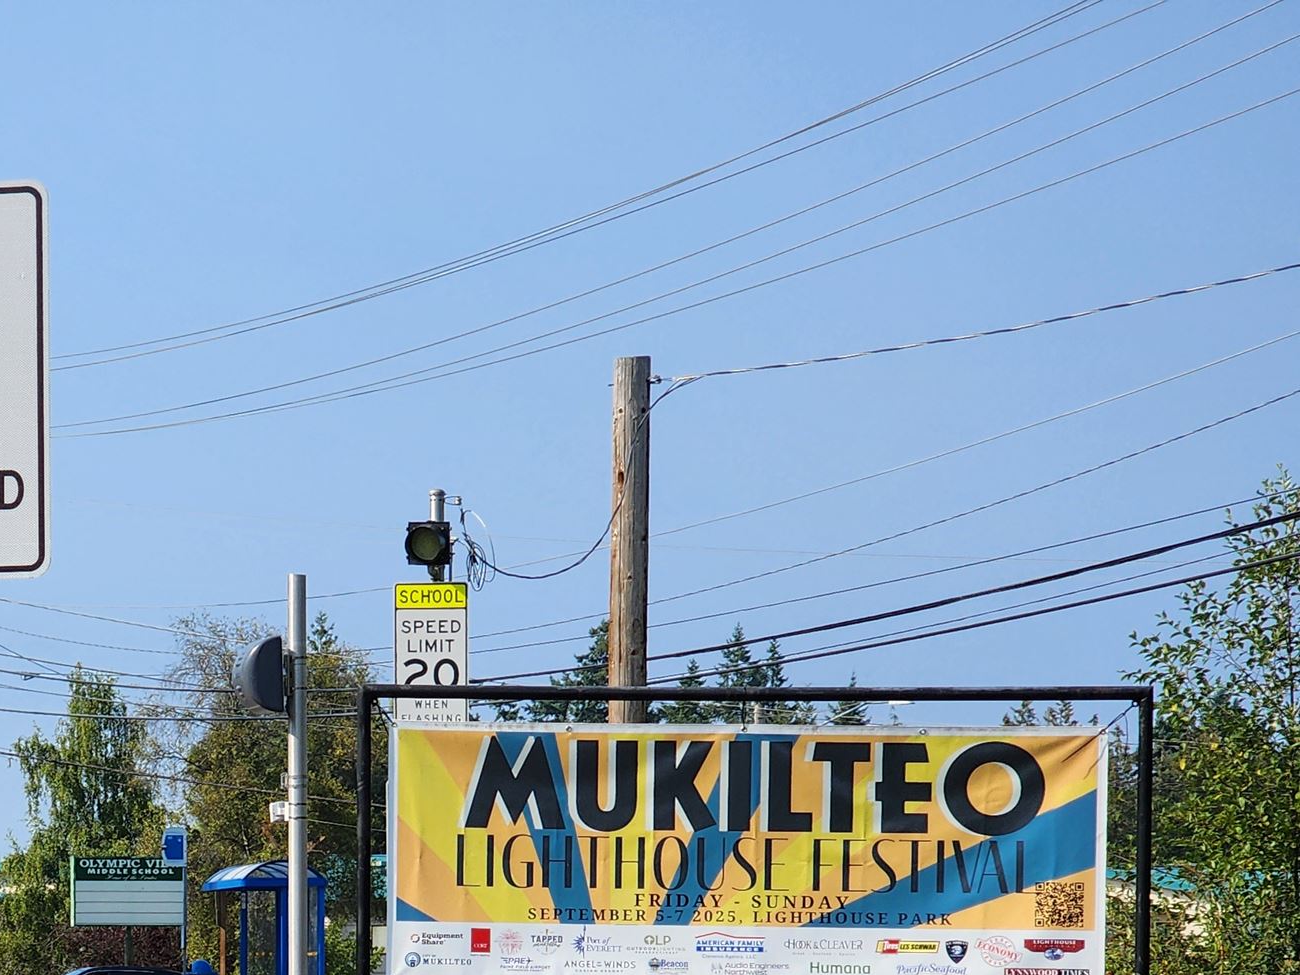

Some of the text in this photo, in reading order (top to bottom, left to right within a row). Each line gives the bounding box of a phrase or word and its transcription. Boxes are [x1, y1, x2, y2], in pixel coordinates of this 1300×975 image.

[400, 589, 464, 603] SCHOOL
[402, 620, 461, 634] SPEED
[408, 639, 455, 653] LIMIT
[404, 658, 460, 686] 20
[415, 700, 448, 709] WHEN
[458, 735, 1046, 837] MUKILTEO
[79, 859, 180, 868] OLYMPIC VIE
[456, 834, 1038, 895] LIGHTHOUSE FESTIVAL
[634, 893, 723, 908] FRIDAY
[751, 895, 850, 909] SUNDAY
[528, 907, 952, 926] SEPTEMBER 5-7 2025, LIGHTHOUSE PARK
[422, 932, 463, 940] Equipment
[531, 935, 563, 943] TAPPED
[586, 936, 612, 945] Port of
[586, 945, 622, 953] EVERETT
[820, 939, 863, 950] CLEAVER
[977, 940, 1020, 961] ECONOMY
[422, 958, 472, 966] MUKILTEO
[564, 960, 596, 968] ANGEL
[604, 961, 636, 969] WINDS
[660, 959, 688, 967] Beacon
[749, 963, 789, 971] Engineers
[810, 962, 871, 974] Humana
